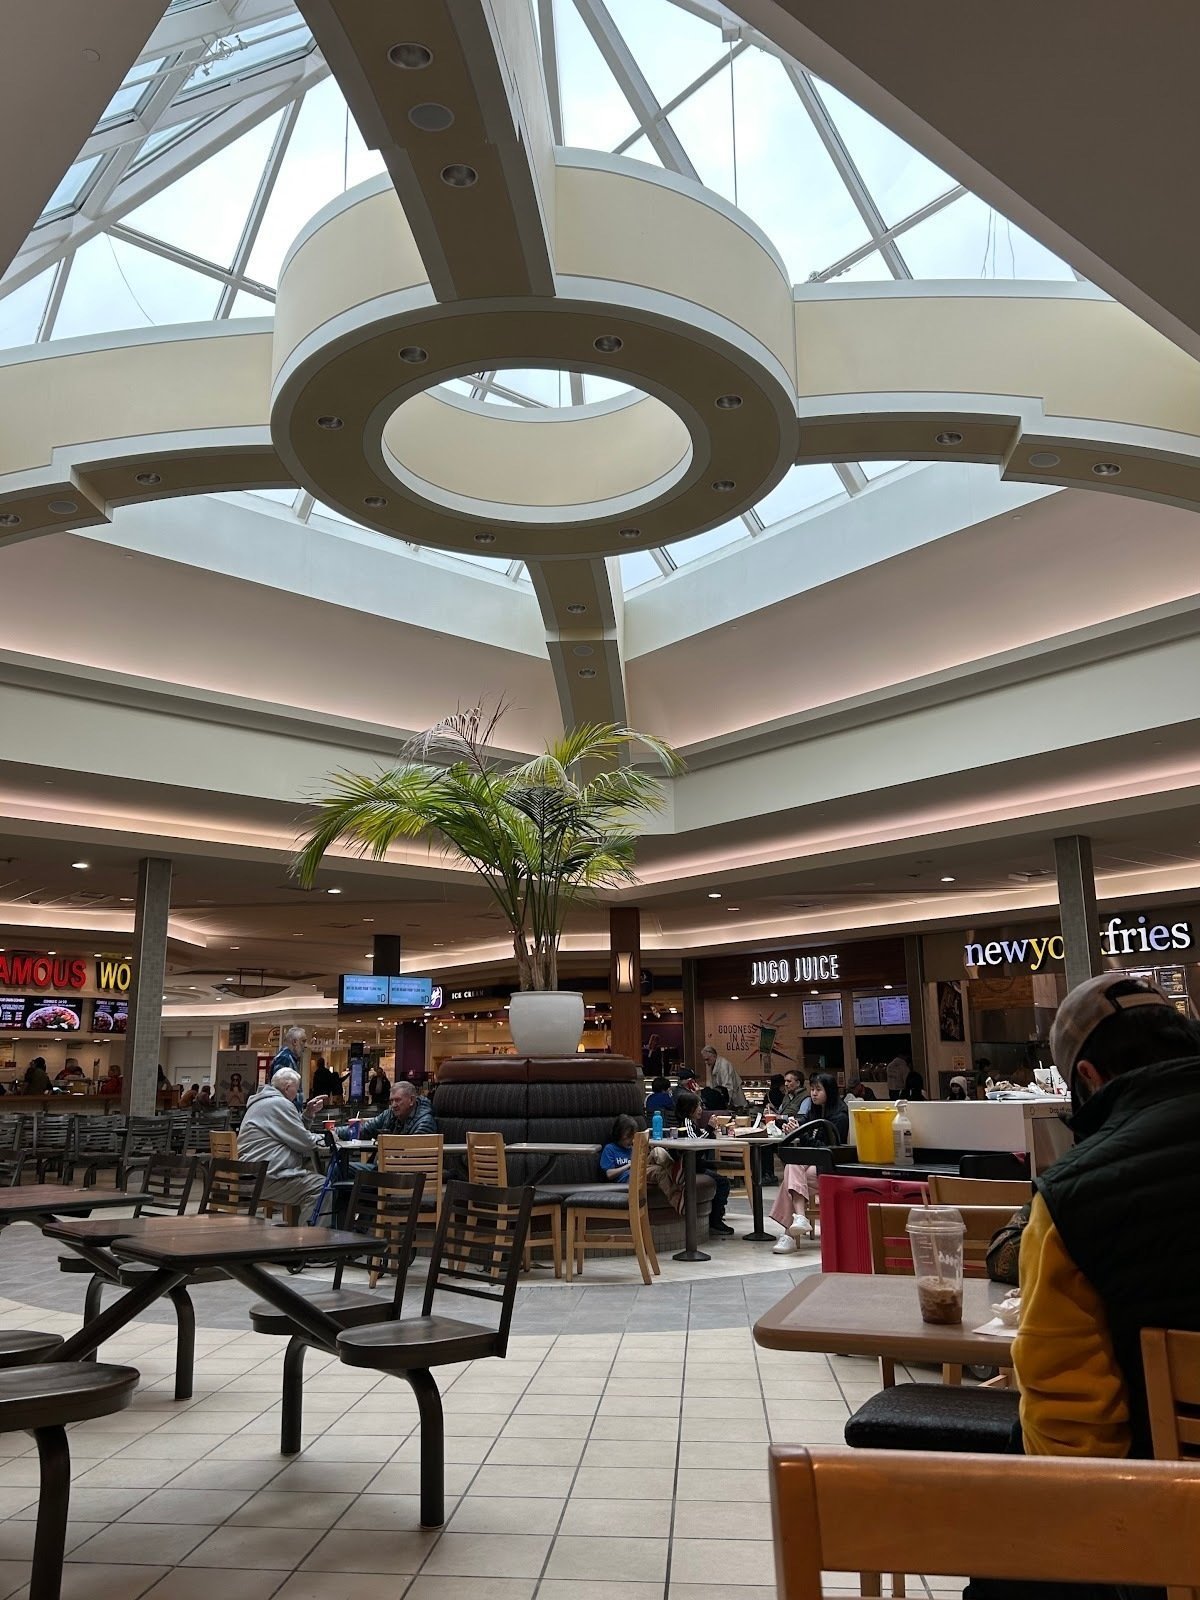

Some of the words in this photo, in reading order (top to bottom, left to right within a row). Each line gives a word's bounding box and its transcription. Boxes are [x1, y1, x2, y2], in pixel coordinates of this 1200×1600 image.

[0, 956, 86, 987] AMOUS
[100, 961, 131, 990] WO
[751, 960, 789, 985] JUGO
[794, 954, 839, 981] JUICE
[718, 1024, 757, 1034] GOODNESS
[729, 1034, 737, 1043] IN
[740, 1034, 745, 1043] A
[726, 1042, 749, 1051] GLASS
